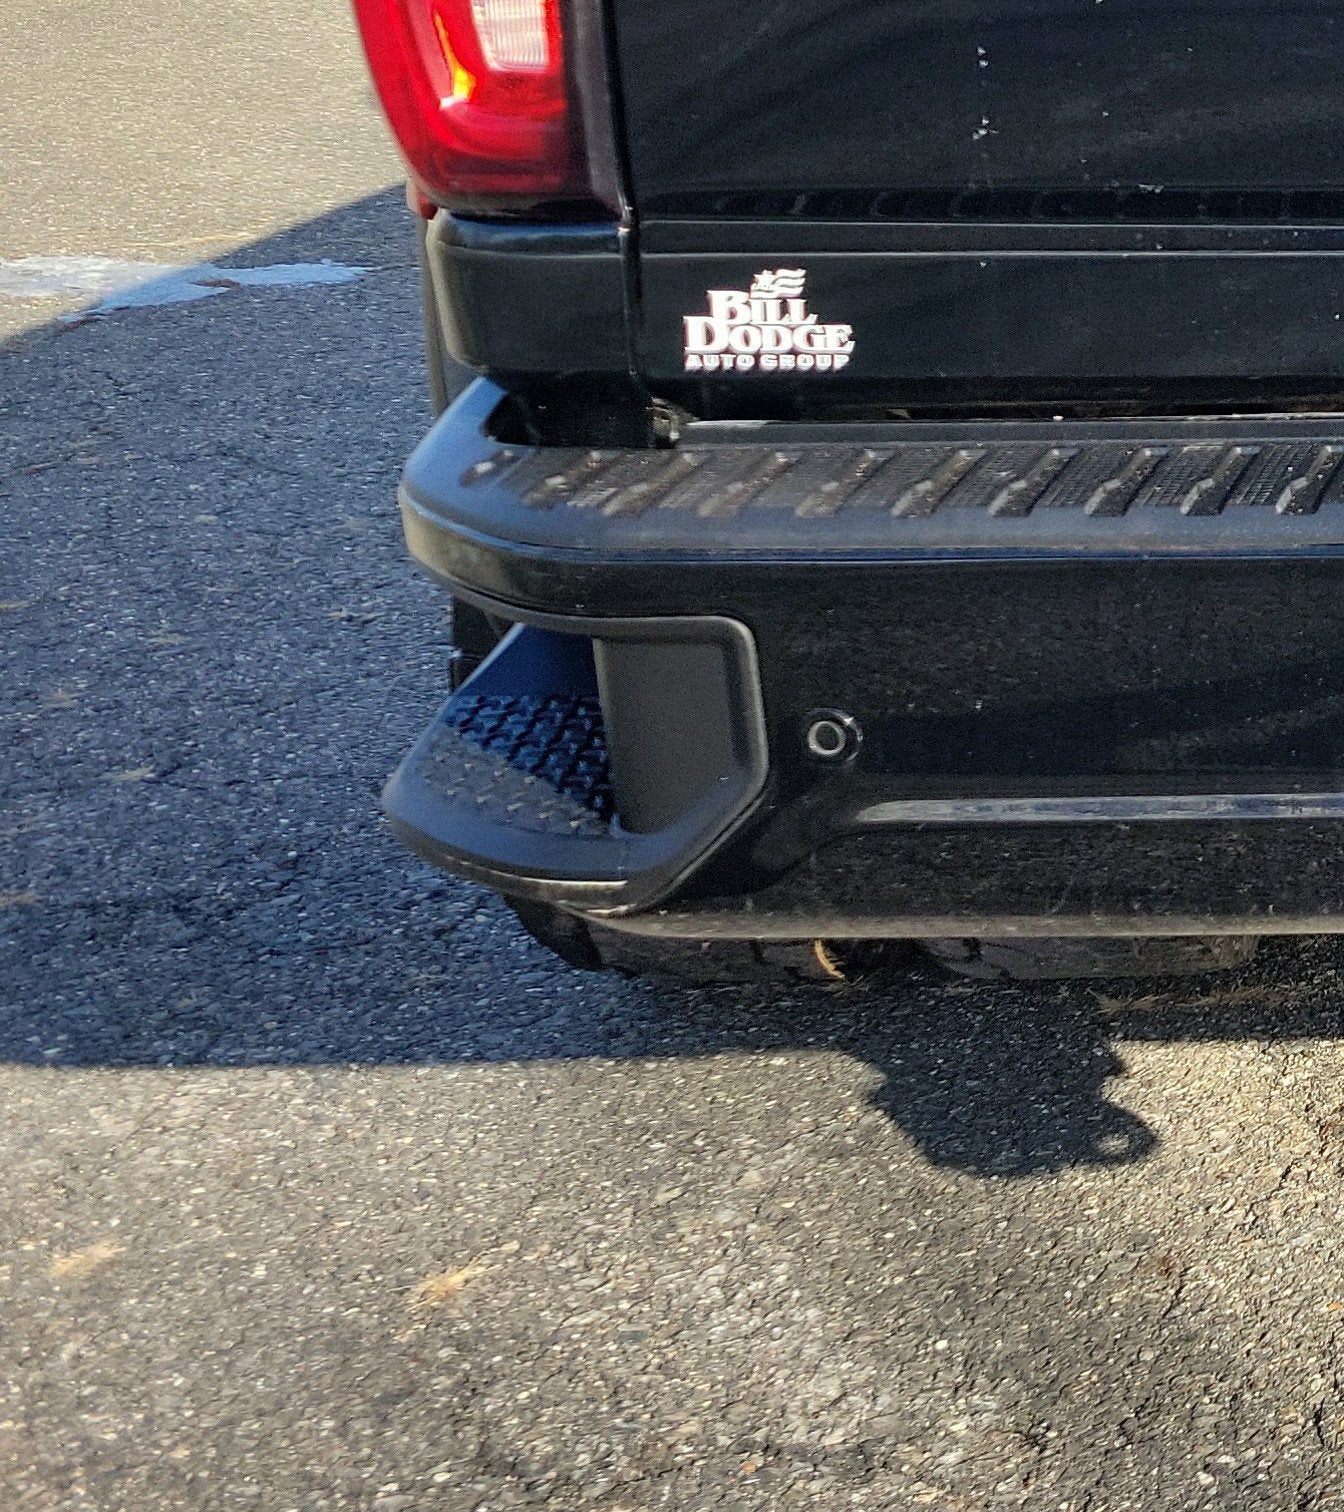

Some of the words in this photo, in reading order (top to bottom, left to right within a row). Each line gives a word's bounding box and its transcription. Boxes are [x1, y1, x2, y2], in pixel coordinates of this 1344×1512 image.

[706, 289, 819, 325] BILL
[682, 315, 856, 354] DODGE
[684, 353, 755, 370] AUTO
[759, 353, 850, 370] GROUP
